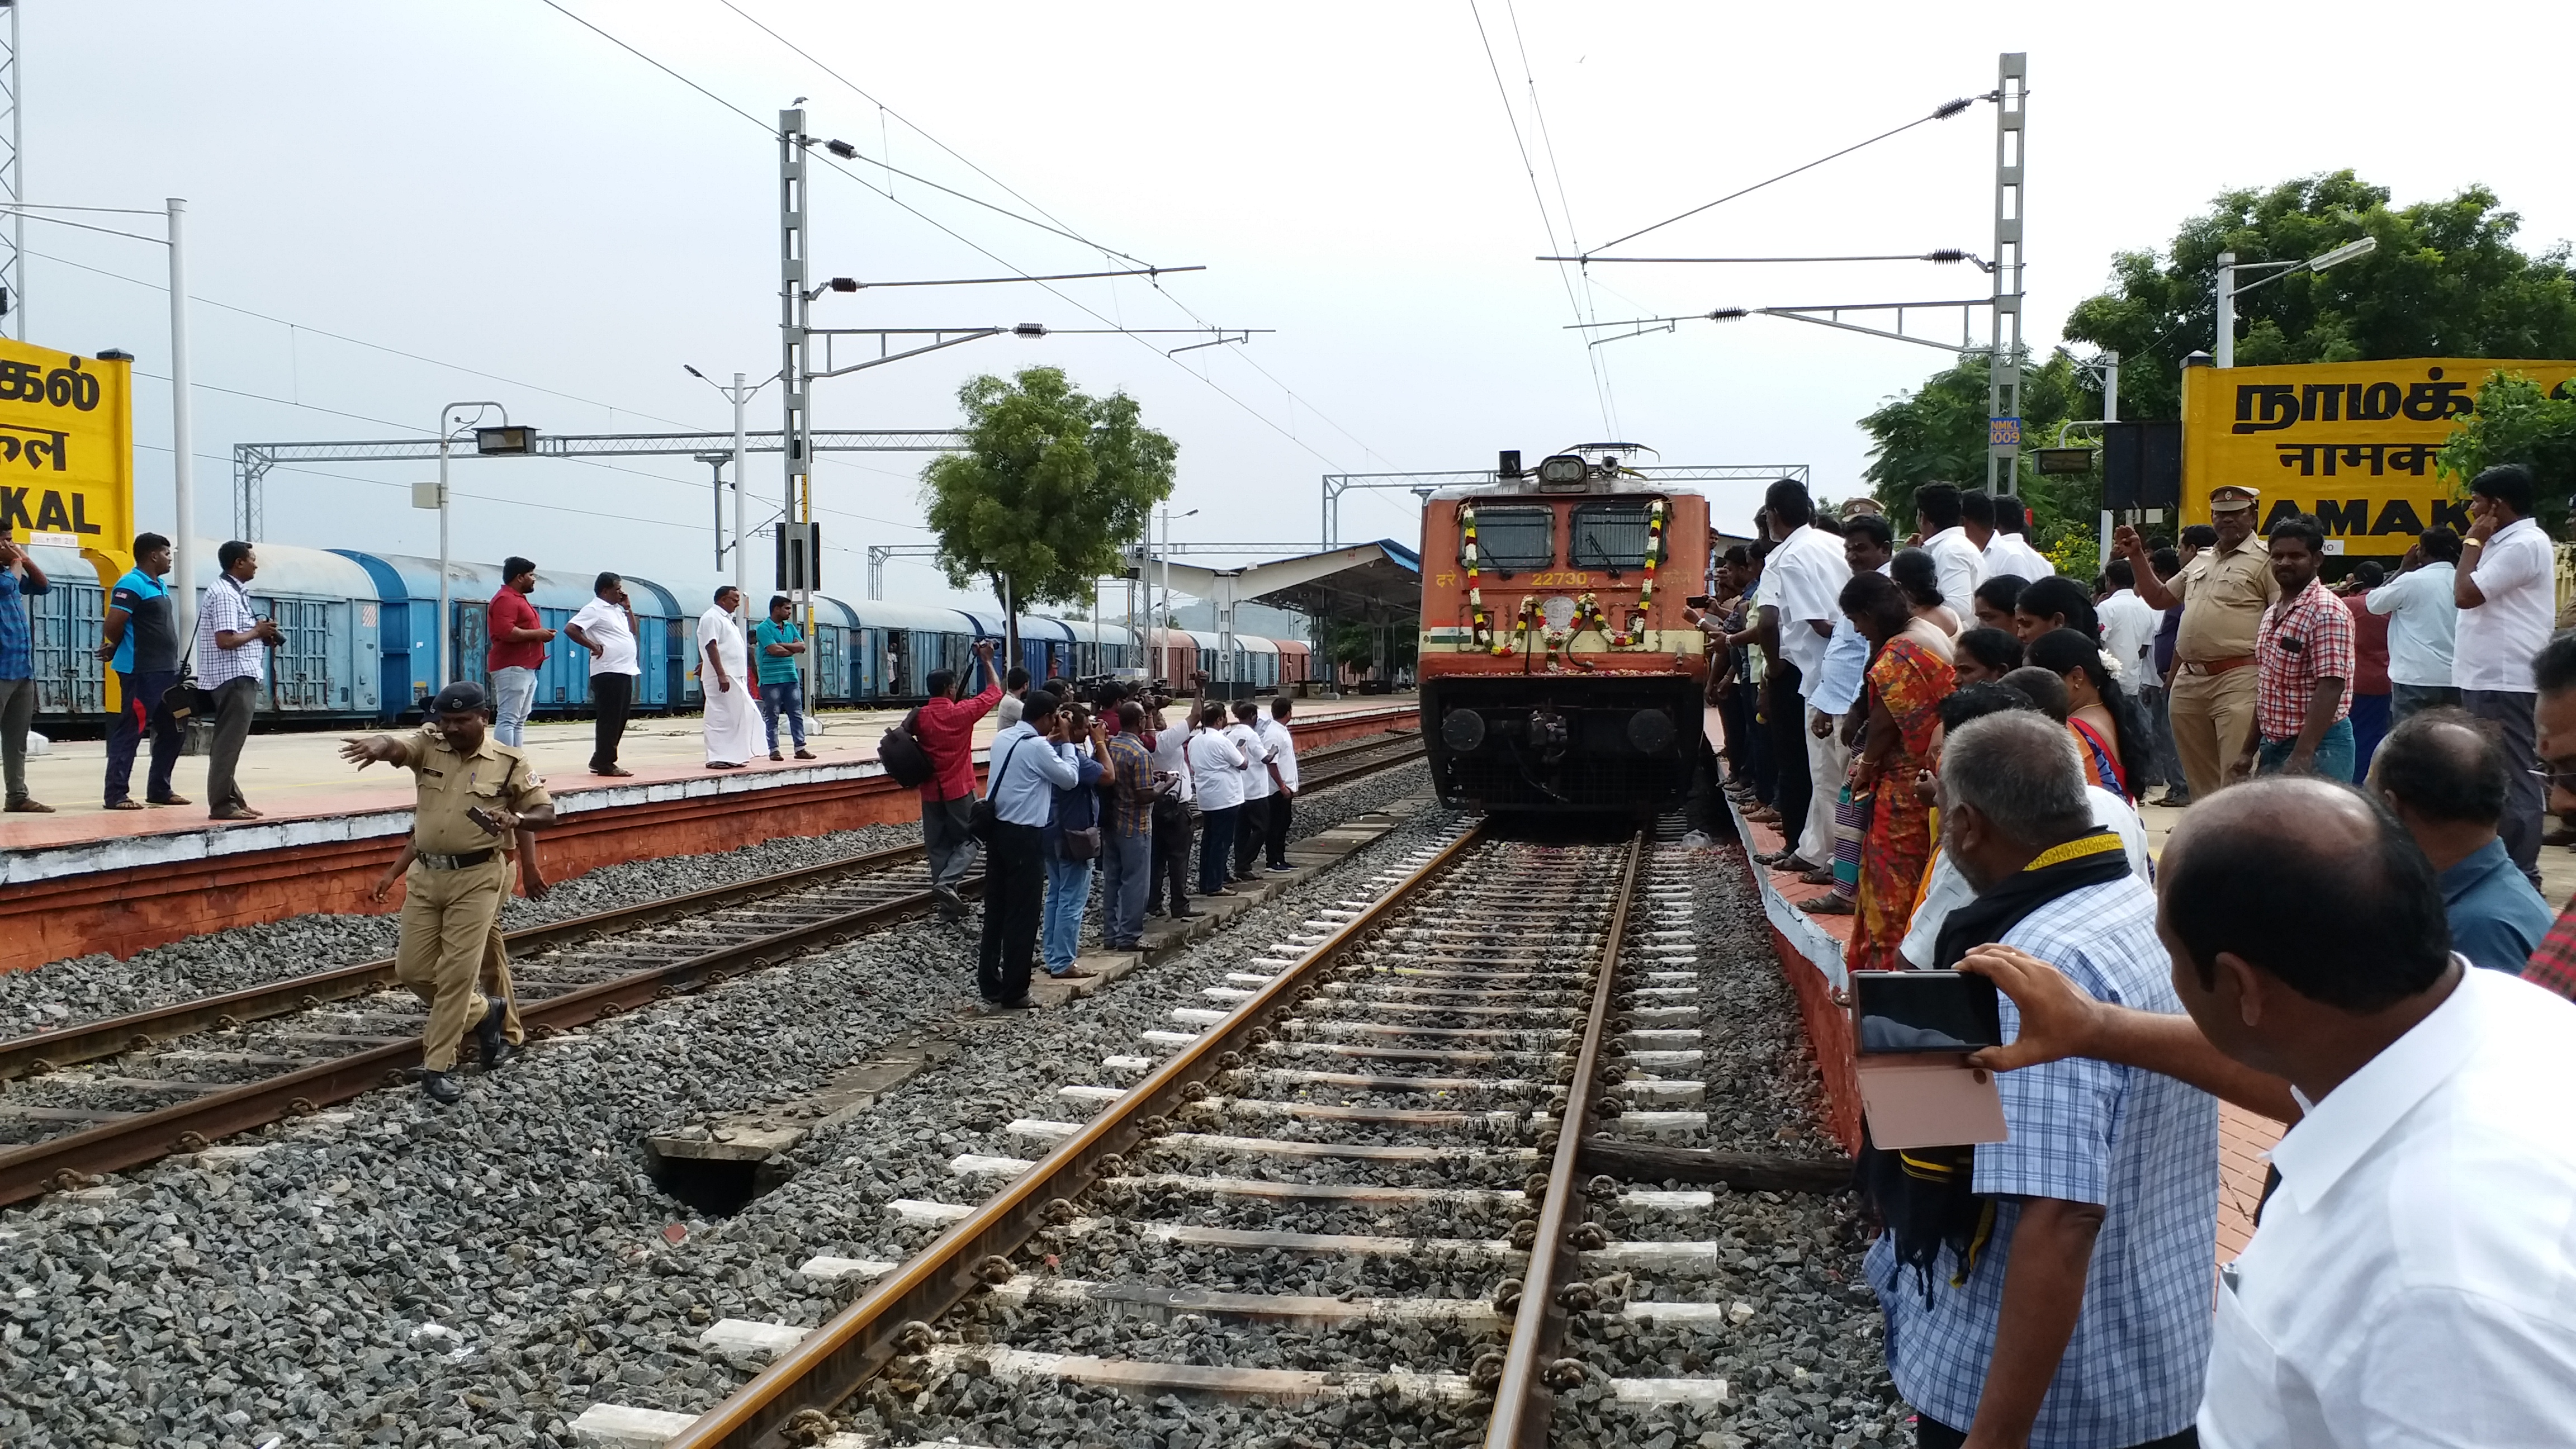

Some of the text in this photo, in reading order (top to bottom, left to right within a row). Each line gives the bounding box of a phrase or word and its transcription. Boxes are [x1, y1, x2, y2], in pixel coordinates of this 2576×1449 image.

[2232, 367, 2576, 434] நாமக்
[1990, 431, 2020, 444] 1009
[1991, 420, 2020, 430] NMKL
[0, 485, 101, 535] KAL
[2255, 499, 2474, 536] AMAK
[1531, 572, 1587, 585] 22730
